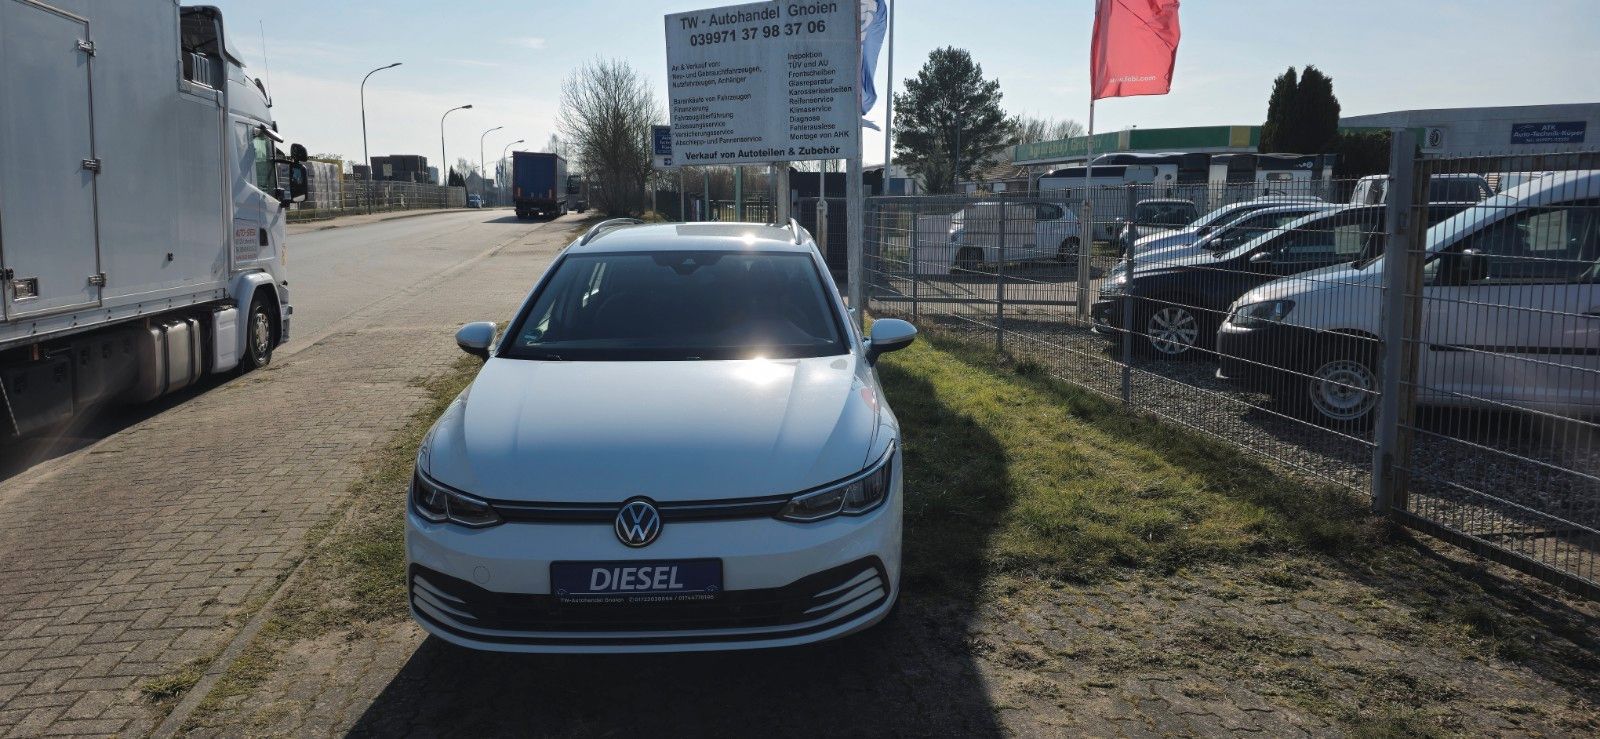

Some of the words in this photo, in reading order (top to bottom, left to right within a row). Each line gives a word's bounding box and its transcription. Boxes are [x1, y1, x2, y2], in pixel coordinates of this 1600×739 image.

[680, 17, 699, 30] TW
[709, 6, 780, 27] Autohandel
[787, 2, 837, 17] Gnoien
[689, 30, 737, 46] 039971
[742, 27, 758, 40] 37
[763, 25, 780, 38] 98
[785, 23, 802, 36] 37
[807, 20, 826, 33] 06
[787, 52, 823, 60] Inspektion
[686, 62, 707, 70] Verkauf
[804, 60, 817, 68] und
[788, 69, 836, 78] Frontscheiben
[788, 78, 834, 87] Glasreparatur
[789, 86, 852, 96] Karosseriearbeiten
[717, 93, 752, 102] Fahrzeugen
[789, 96, 834, 105] Reifenservice
[673, 105, 709, 113] Finanzierung
[789, 105, 832, 114] Klimaservice
[789, 115, 821, 123] Diagnose
[789, 123, 836, 131] Fehlerauslese
[675, 129, 734, 138] Versicherungsservice
[790, 133, 818, 141] Montage
[833, 130, 850, 138] AHK
[706, 137, 718, 145] und
[719, 135, 762, 145] Pannenservice
[685, 150, 718, 160] Verkauf
[720, 151, 736, 159] von
[738, 148, 786, 158] Autoteilen
[788, 147, 796, 155] &
[798, 145, 841, 156] Zubehör
[589, 565, 684, 591] DIESEL
